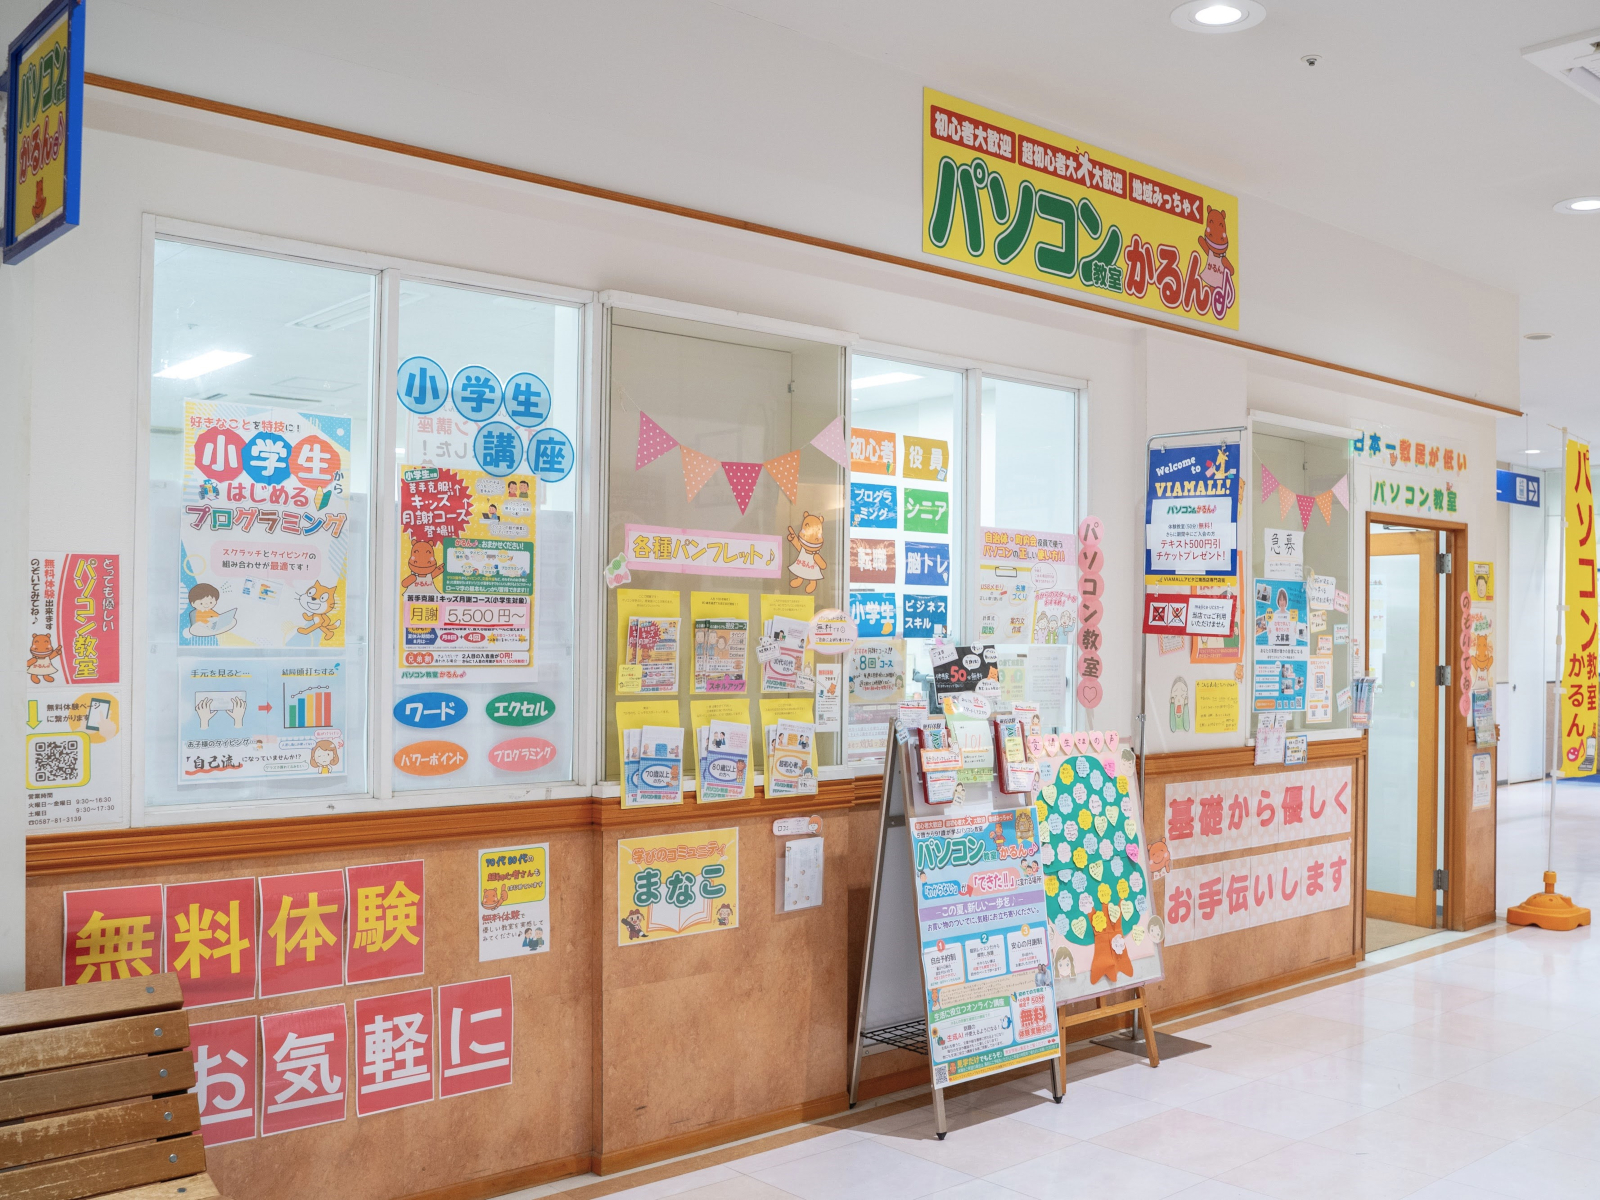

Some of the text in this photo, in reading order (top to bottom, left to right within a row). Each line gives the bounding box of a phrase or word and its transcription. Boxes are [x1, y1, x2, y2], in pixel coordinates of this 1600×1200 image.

[18, 42, 67, 133] パソコン
[934, 111, 1012, 157] 初心者大歓迎
[19, 116, 52, 184] かるん
[1132, 178, 1200, 219] 地域みっちゃく
[929, 156, 1212, 316] パソコン 教室 かるん
[405, 367, 543, 419] 小学生
[189, 415, 301, 433] 好きなことを特技に!
[483, 430, 566, 474] 講座
[851, 435, 894, 462] 初心者
[909, 445, 943, 470] 役員
[201, 435, 344, 495] 小学生 から
[1155, 457, 1196, 477] Welcome
[1191, 465, 1201, 475] to
[226, 481, 309, 507] はじめる
[409, 481, 452, 493] 苦手克服!
[854, 489, 892, 503] プログラ
[1155, 479, 1231, 497] VIAMALL!
[1373, 480, 1457, 512] パソコン教室
[411, 491, 453, 509] キッズ
[906, 497, 946, 521] シニア
[185, 504, 348, 538] プログラミング
[403, 509, 468, 525] 月謝コース
[860, 507, 888, 520] ミング
[424, 525, 455, 537] 登場!!
[222, 547, 316, 560] スクラッチとタイピングの
[632, 535, 763, 565] 各種パンフレット
[1161, 538, 1221, 549] テキスト500円引
[1270, 533, 1295, 555] 急募
[222, 559, 310, 571] 組み合わせが最適です!
[858, 547, 887, 571] 転職
[907, 552, 948, 574] 脳トレ
[1156, 551, 1226, 561] チケットプレゼント!
[30, 558, 40, 616] のぞいてみてね
[44, 559, 55, 631] 無料体験出来ます
[102, 558, 115, 632] とっても優しい
[905, 600, 945, 613] ビジネス
[1082, 522, 1100, 679] パソコン教室
[74, 558, 98, 680] パソコン教室
[411, 607, 438, 621] 月謝
[851, 601, 895, 625] 小学生
[905, 617, 931, 629] スキル
[1191, 611, 1227, 620] 当店ではご利用
[1191, 620, 1226, 628] いただけません
[1462, 595, 1471, 690] のぞいてね
[709, 681, 745, 691] スキルアップ
[1567, 653, 1585, 738] かるん
[46, 701, 101, 711] 無料体験ページ
[405, 701, 456, 722] ワード
[494, 700, 549, 717] エクセル
[46, 714, 89, 723] に繋がります
[400, 752, 464, 767] パワーポイント
[493, 745, 553, 763] プログラミング
[645, 770, 670, 778] 70歳以上
[712, 763, 737, 772] 80歳以上
[1168, 781, 1348, 841] 基礎から優しく
[631, 841, 726, 864] 学びのコミュニティ
[917, 836, 985, 871] パソコン
[999, 843, 1028, 860] かるん
[633, 864, 726, 908] まなこ
[1167, 855, 1347, 924] お手伝いします
[482, 910, 525, 925] 無料体験で
[941, 898, 1010, 917] この夏、新しい一歩を
[75, 880, 421, 985] 無料体験
[482, 932, 517, 942] みてください
[1020, 1005, 1048, 1027] 無料
[188, 1007, 506, 1113] お気軽に
